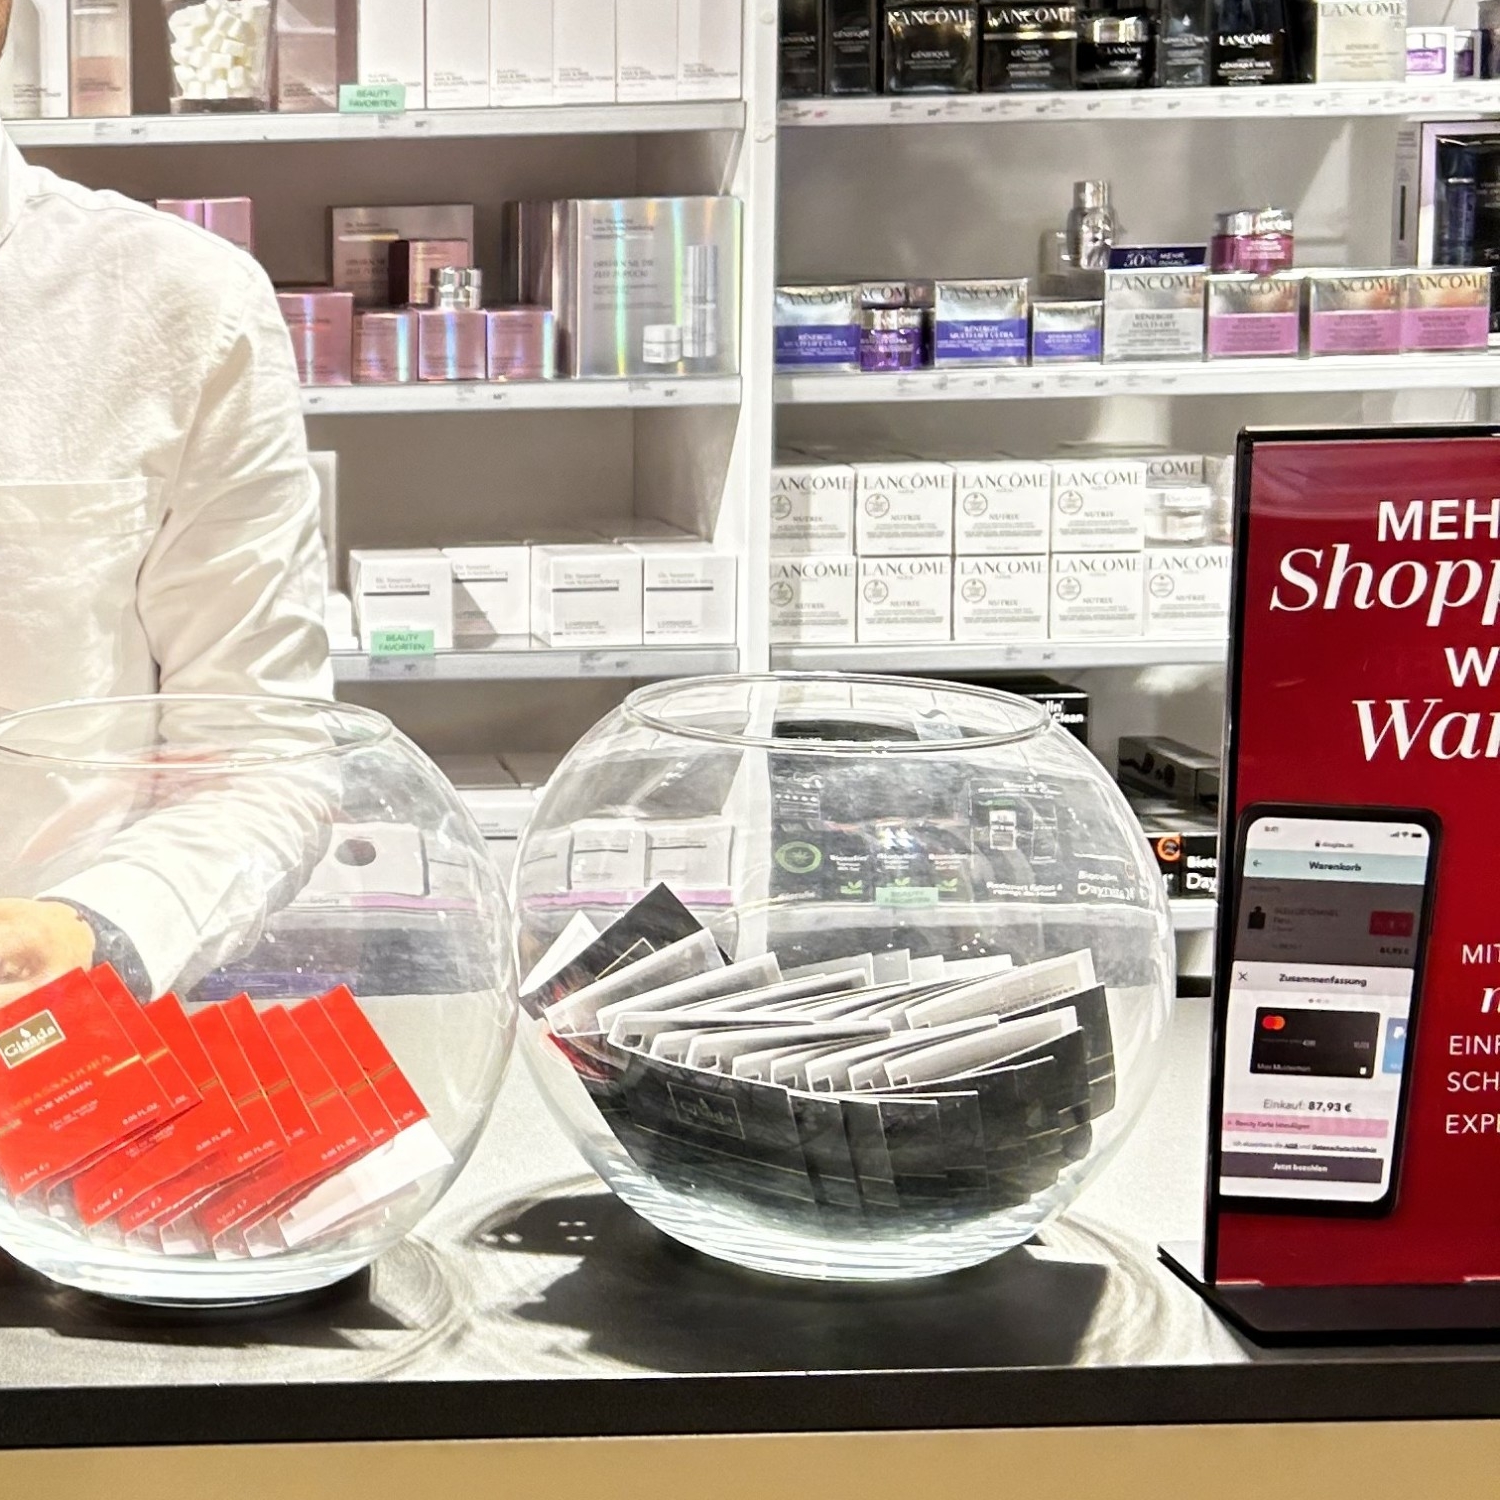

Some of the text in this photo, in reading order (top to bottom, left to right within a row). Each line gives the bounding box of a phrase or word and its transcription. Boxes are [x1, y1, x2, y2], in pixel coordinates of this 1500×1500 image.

[385, 634, 418, 642] BEAUTY
[378, 643, 425, 652] FAVORITEN
[1308, 860, 1362, 873] Warenkorb
[1279, 973, 1368, 988] Zusammenfassung
[3, 1024, 57, 1057] Gisada
[54, 1079, 94, 1105] WOMEN
[1307, 1101, 1342, 1113] 87,93
[1344, 1102, 1352, 1113] €
